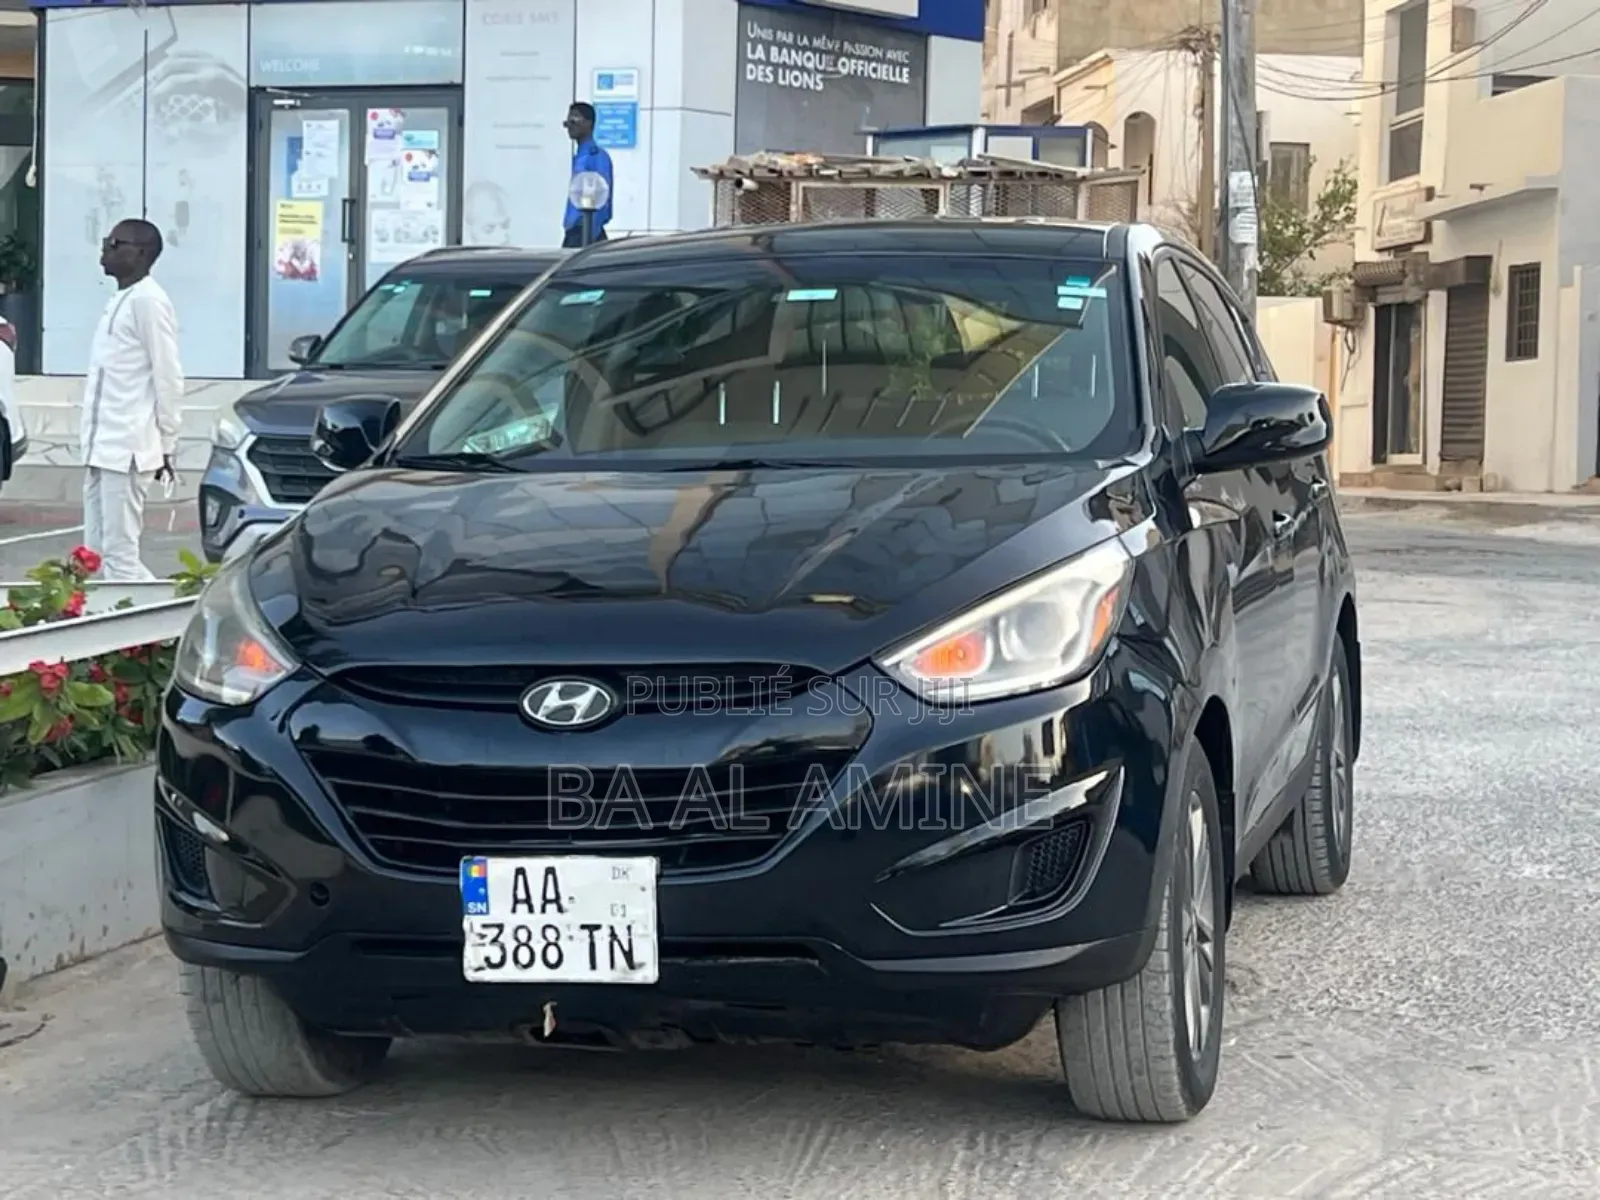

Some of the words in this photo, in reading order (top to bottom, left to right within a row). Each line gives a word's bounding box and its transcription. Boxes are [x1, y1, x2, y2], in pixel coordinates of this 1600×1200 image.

[776, 32, 794, 45] PAR
[797, 36, 809, 46] LA
[886, 48, 910, 63] AVEC
[260, 58, 320, 72] WELCOME
[746, 64, 774, 83] DES
[778, 67, 824, 91] LIONS
[747, 43, 765, 60] LA
[838, 57, 910, 84] OFFICIELLE
[511, 866, 565, 914] AA
[467, 902, 487, 913] SN
[480, 923, 564, 970] 388
[579, 924, 637, 971] TN
